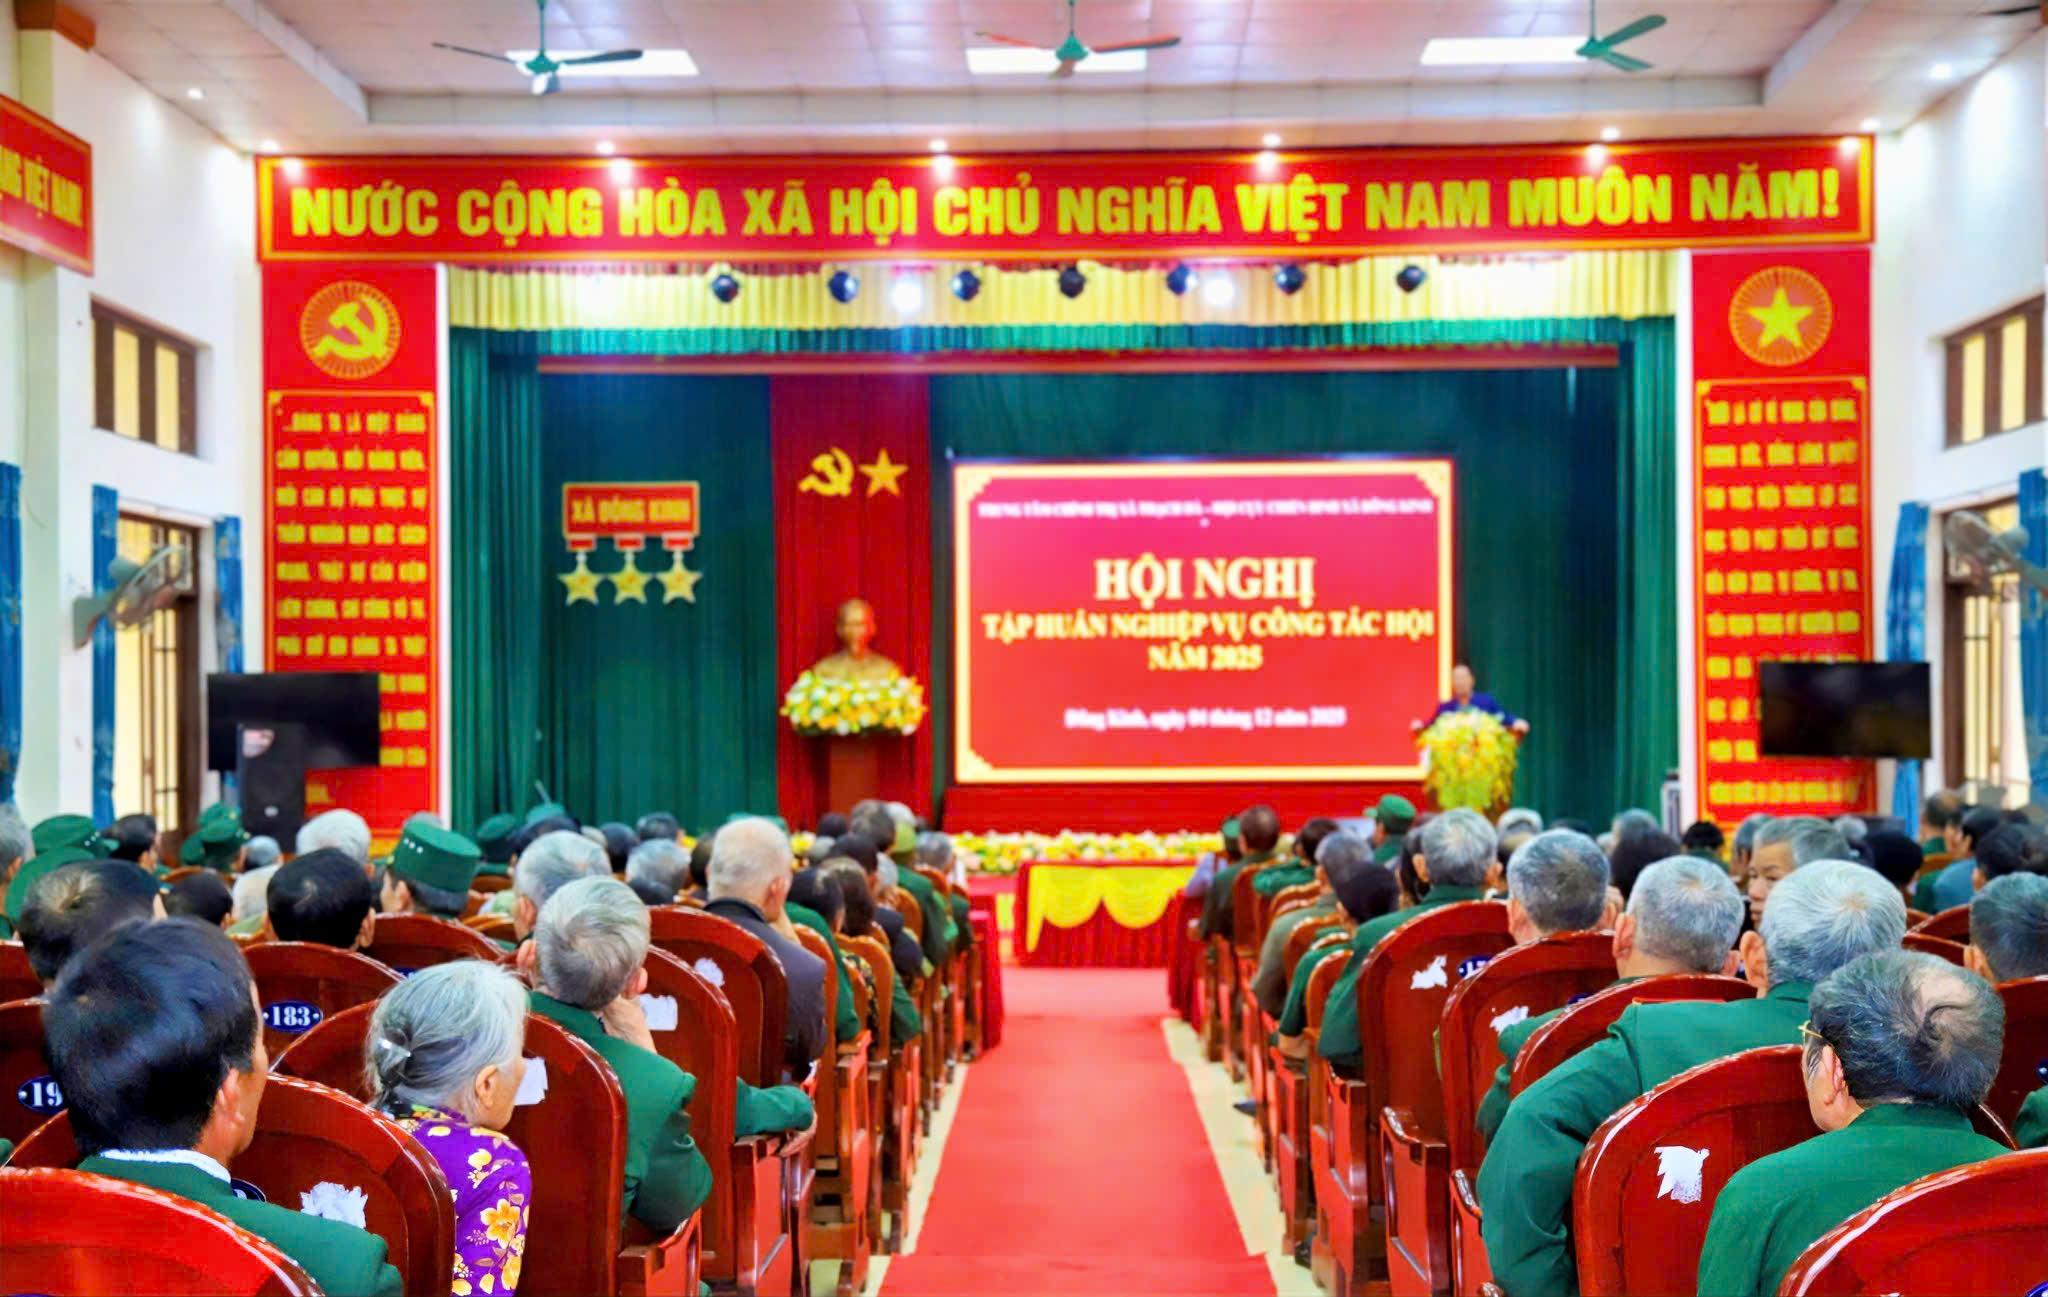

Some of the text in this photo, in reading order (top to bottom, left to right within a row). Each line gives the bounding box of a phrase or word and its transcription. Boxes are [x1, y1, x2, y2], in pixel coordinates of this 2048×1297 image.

[291, 162, 1839, 247] NƯỚC CỘNG HÒA XÃ HỘI CHỦ NGHĨA VIỆT NAM MUÔN NĂM!
[572, 496, 595, 522] XÃ
[1094, 551, 1315, 611] HỘI NGHỊ
[981, 609, 1033, 645] TẬP
[1111, 609, 1209, 643] NGHIỆP
[1210, 611, 1246, 643] VỤ
[1250, 605, 1326, 638] CÔNG
[1327, 604, 1383, 638] TÁC
[1385, 608, 1435, 642] HỘI
[1147, 641, 1264, 672] NĂM 2025
[273, 1006, 311, 1026] 183
